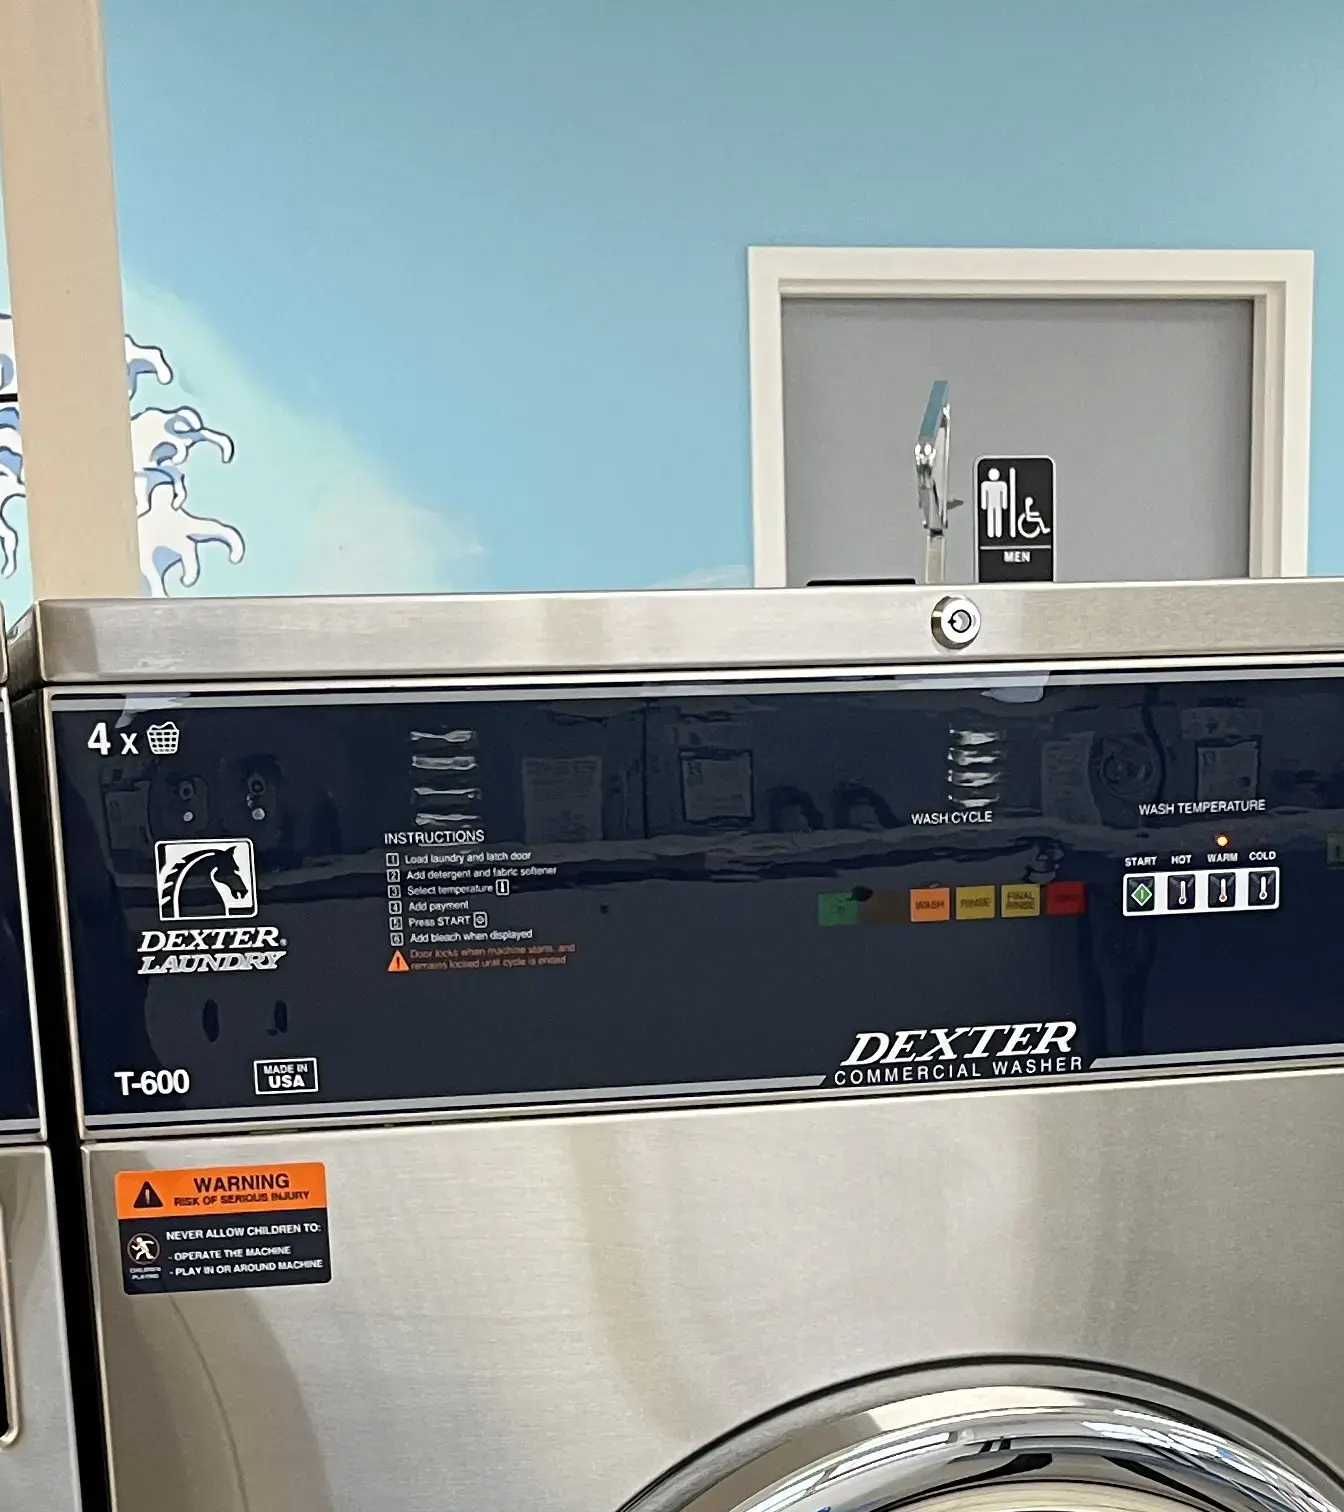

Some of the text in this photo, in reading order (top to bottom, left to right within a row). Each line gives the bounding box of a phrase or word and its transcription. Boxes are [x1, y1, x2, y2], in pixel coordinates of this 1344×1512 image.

[1004, 551, 1030, 562] MEN
[88, 722, 139, 756] 4 x
[1138, 799, 1266, 815] WASH TEMPERATURE
[911, 811, 993, 825] WASH CYCLE
[384, 830, 485, 844] INSTRUCTIONS
[404, 851, 531, 865] Load laundry and latch door
[1124, 851, 1276, 866] START HOT WARM COLD
[407, 866, 557, 880] Add detergent and fabric softener
[407, 883, 493, 896] Select temperature
[408, 901, 469, 912] Add payment
[408, 916, 471, 927] Press START
[410, 929, 532, 943] Add bleach when displayed
[138, 950, 284, 975] LAUNDRY
[841, 1020, 1078, 1067] DEXTER
[263, 1063, 308, 1075] MADE IN
[834, 1056, 1083, 1086] COMMERCIAL WASHER
[115, 1069, 190, 1097] T-600
[268, 1073, 305, 1089] USA
[194, 1173, 289, 1193] WARNING
[174, 1190, 309, 1206] RISK OF SERIOUS INJURY
[166, 1223, 321, 1241] NEVER ALLOW CHILDREN TO:
[174, 1246, 291, 1261] OPERATE THE MACHINE
[175, 1259, 323, 1276] PLAY IN OR AROUND MACHINE
